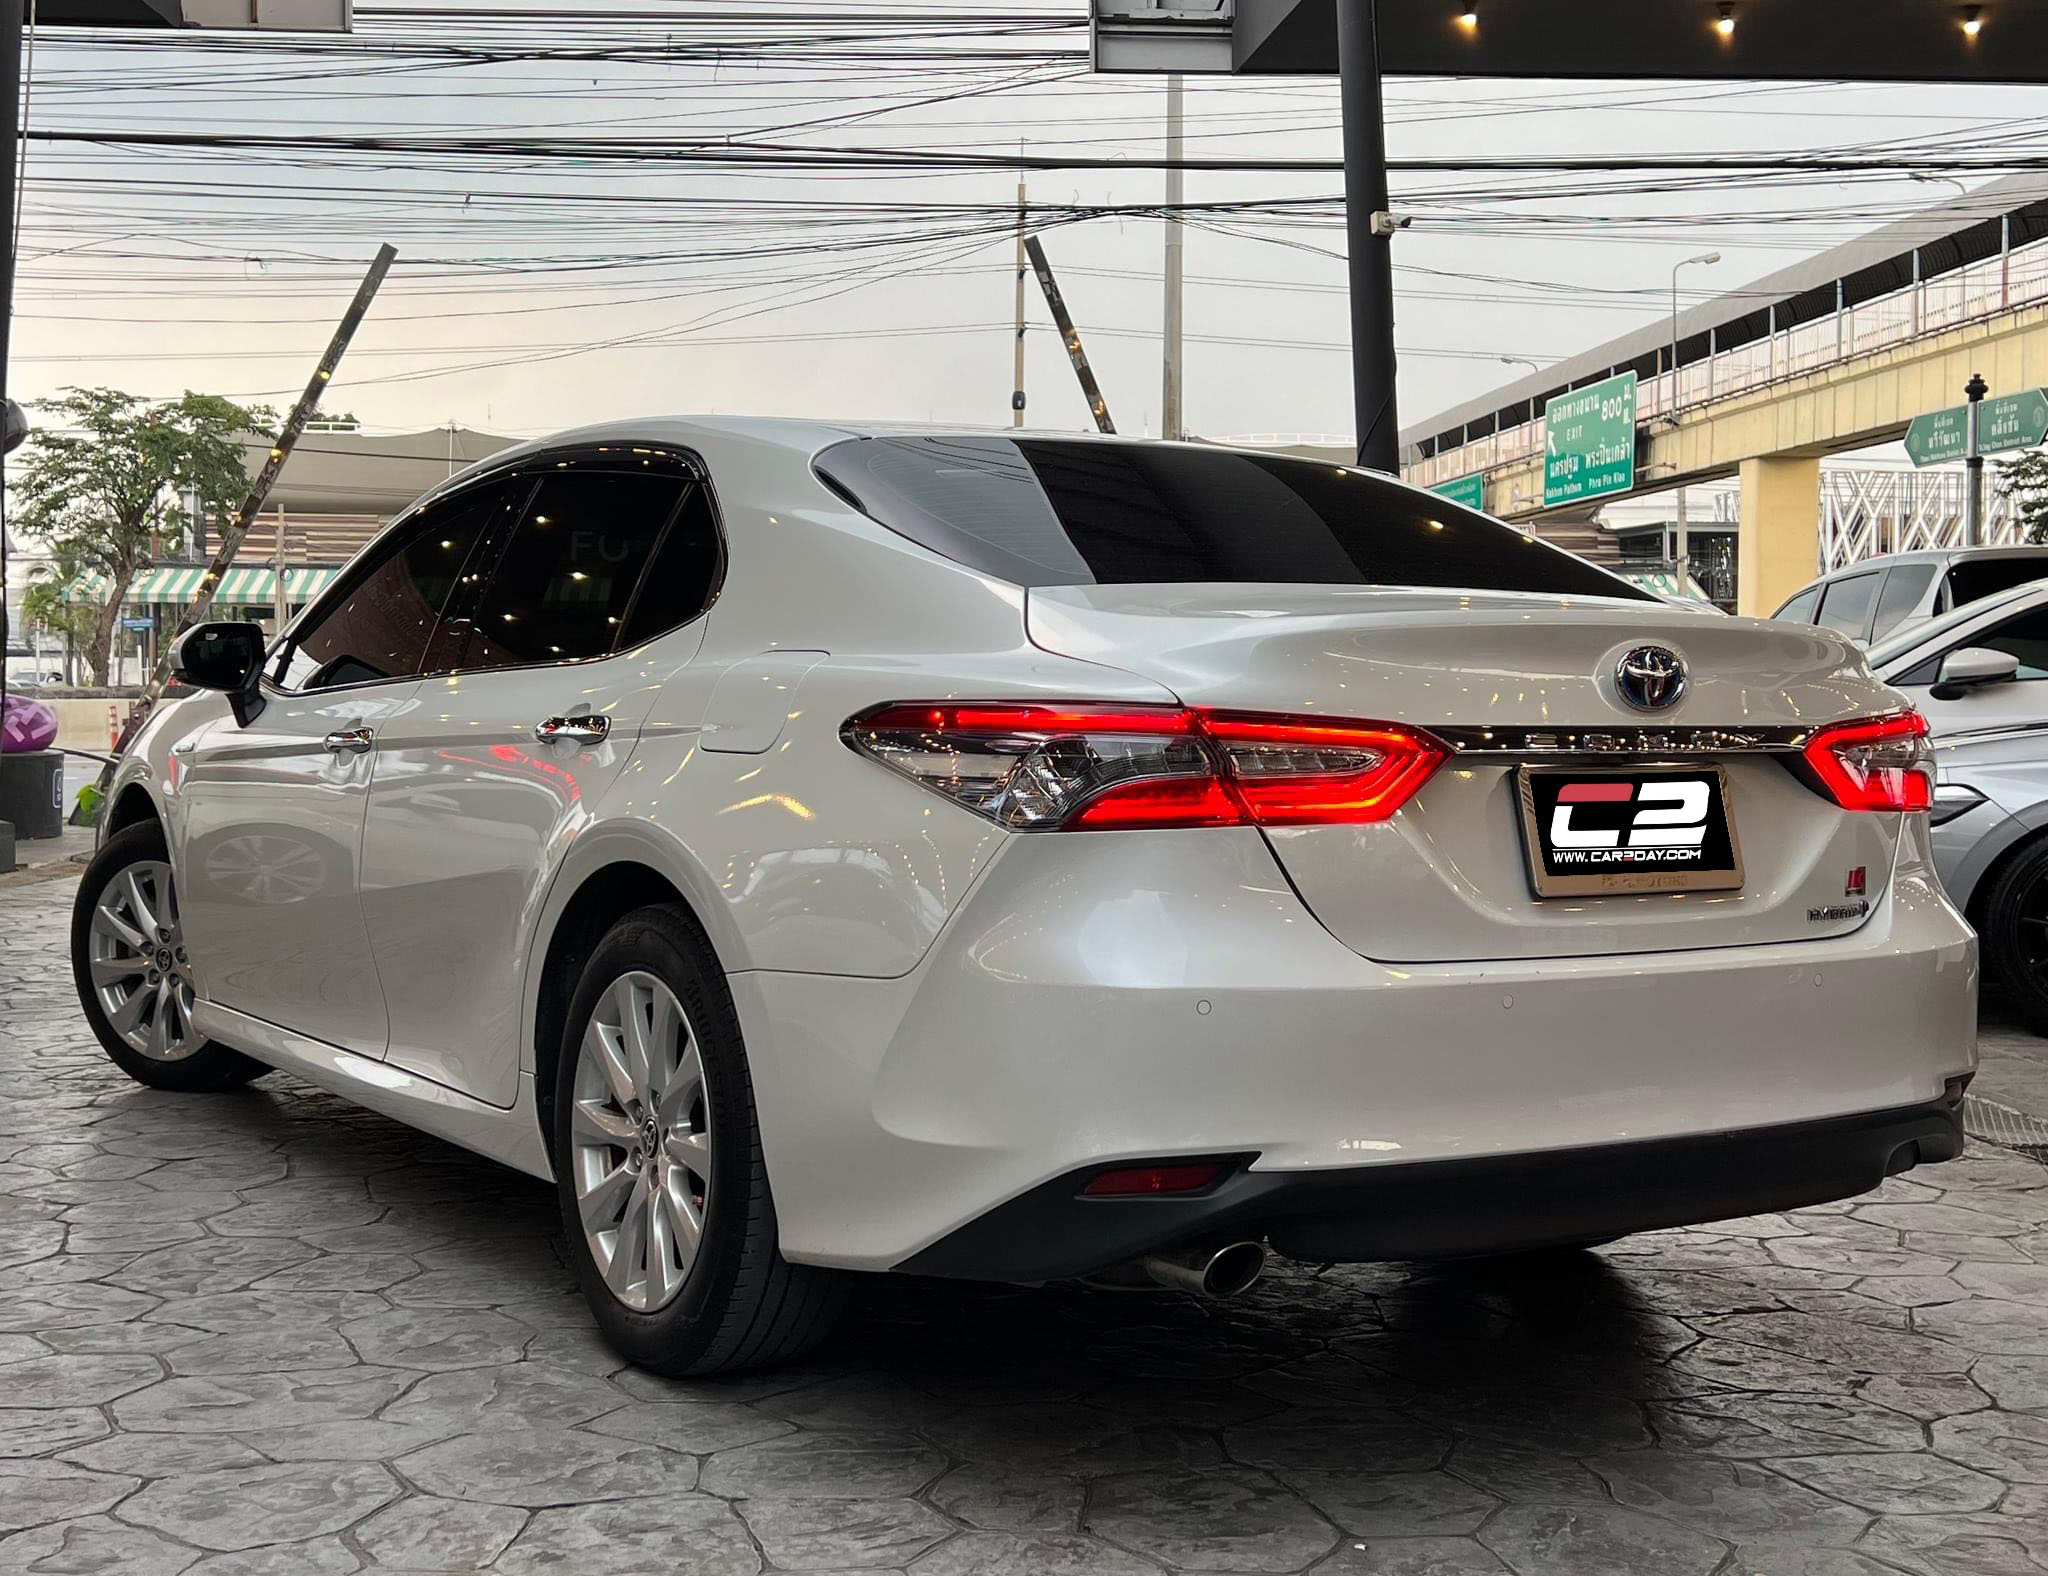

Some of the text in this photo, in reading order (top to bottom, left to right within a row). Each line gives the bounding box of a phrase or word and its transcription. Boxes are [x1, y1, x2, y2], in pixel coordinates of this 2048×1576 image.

[1601, 396, 1622, 422] 800
[1566, 425, 1583, 441] EXIT
[1550, 454, 1579, 480] นครปฐม
